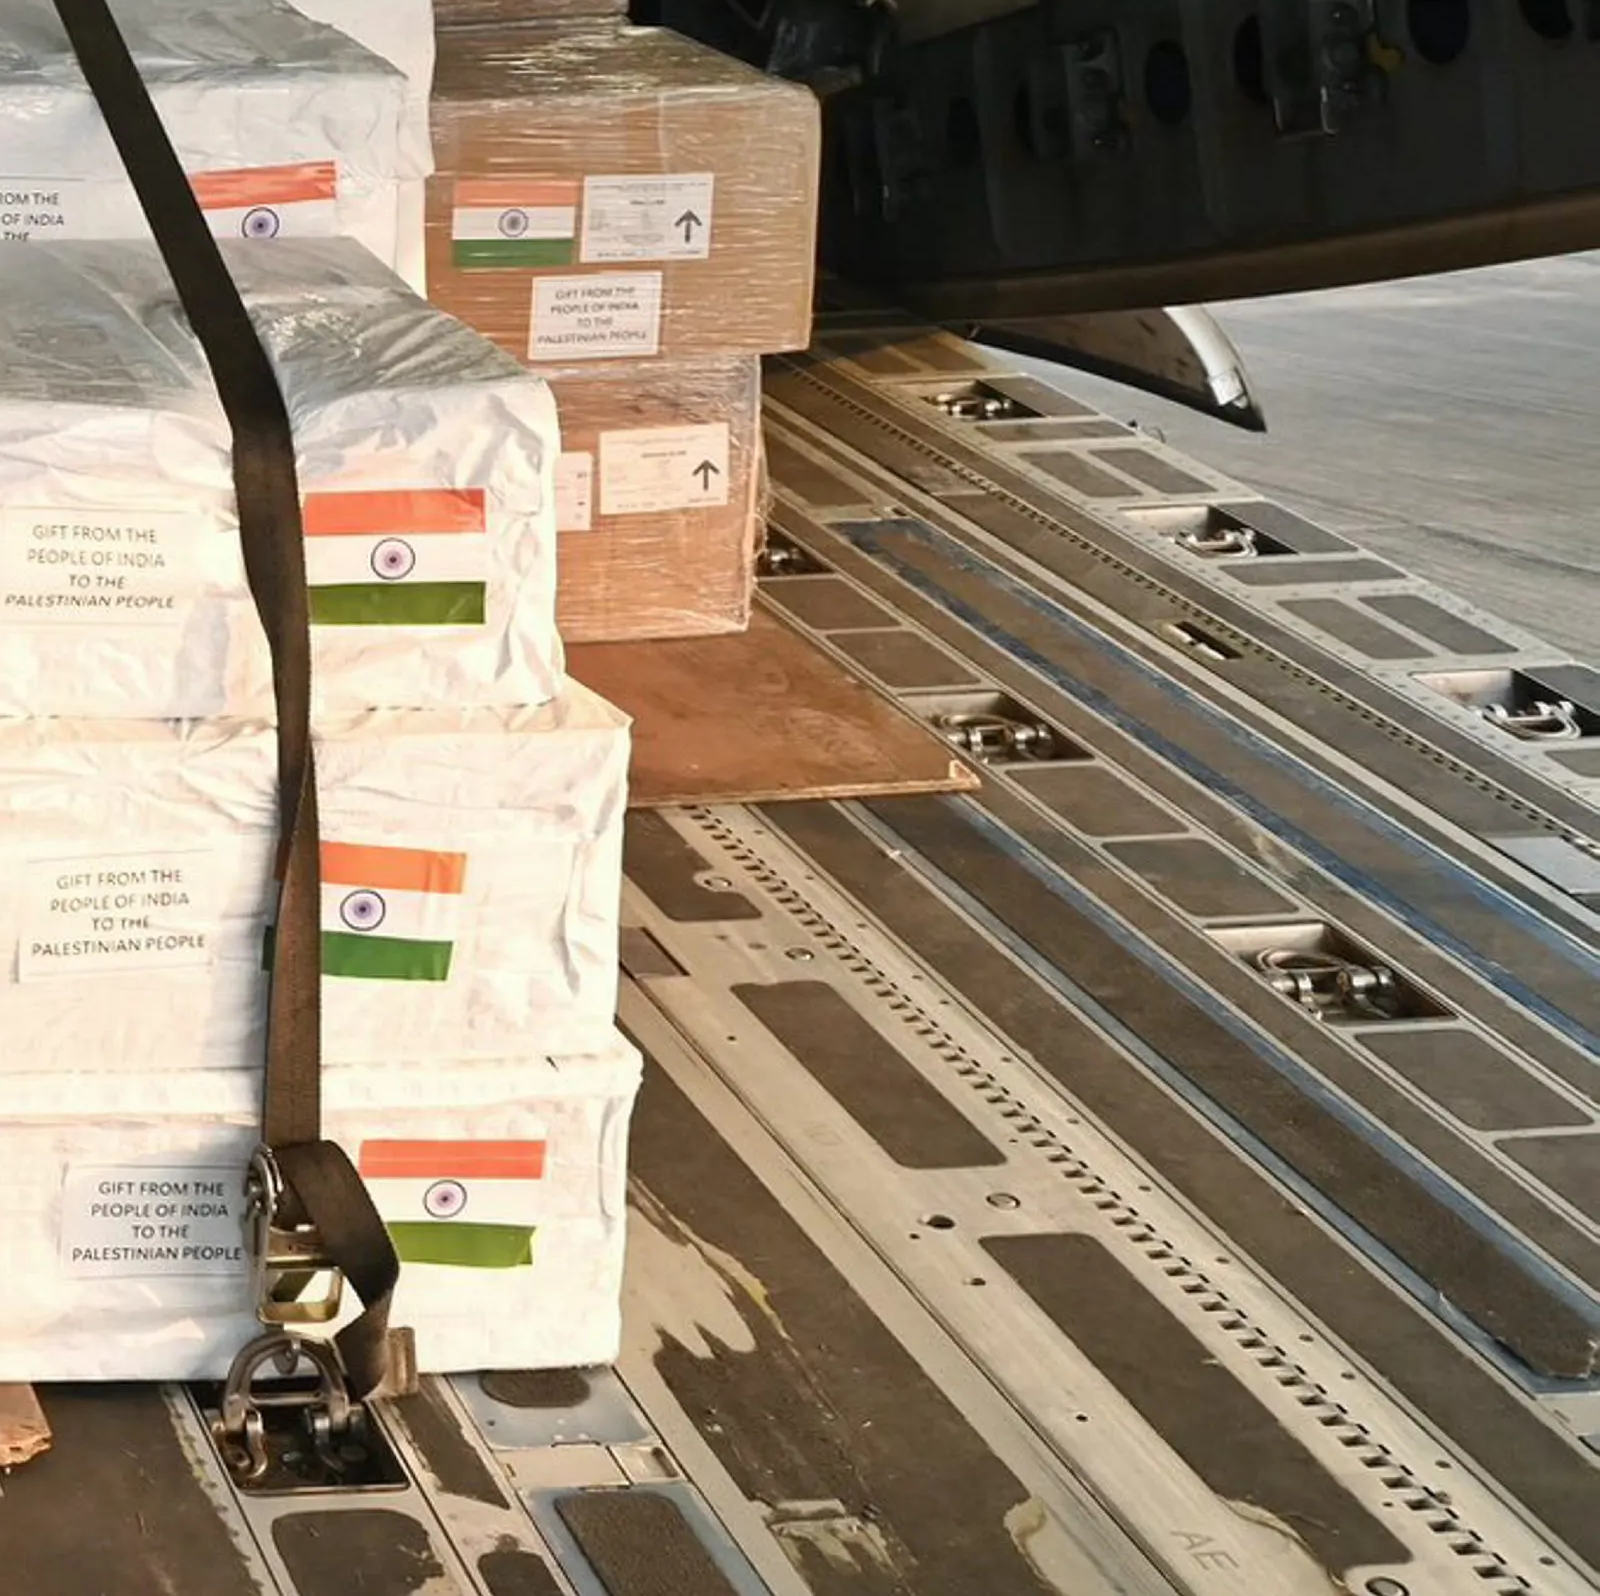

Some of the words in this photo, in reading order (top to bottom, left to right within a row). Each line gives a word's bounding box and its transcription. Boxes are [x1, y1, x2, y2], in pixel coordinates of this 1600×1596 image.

[32, 192, 58, 206] THE
[0, 213, 21, 226] OF
[26, 213, 64, 226] INDIA
[4, 231, 31, 243] THE
[33, 524, 68, 540] GIFT
[73, 525, 121, 542] FROM
[126, 527, 156, 544] THE
[28, 548, 86, 566] PEOPLE
[91, 551, 112, 566] OF
[119, 553, 165, 568] INDIA
[69, 574, 91, 589] TO
[96, 575, 125, 590] THE
[5, 594, 112, 608] PALESTINIAN
[115, 595, 173, 609] PEOPLE
[56, 874, 91, 890] GIFT
[98, 871, 146, 886] FROM
[150, 869, 181, 883] THE
[51, 895, 109, 913] PEOPLE
[114, 894, 134, 909] OF
[143, 892, 190, 907] INDIA
[92, 917, 114, 931] TO
[121, 915, 150, 930] THE
[32, 938, 141, 956] PALESTINIAN
[145, 935, 204, 951] PEOPLE
[98, 1182, 135, 1195] GIFT
[140, 1182, 188, 1196] FROM
[194, 1182, 223, 1196] THE
[91, 1203, 150, 1218] PEOPLE
[155, 1203, 178, 1218] OF
[181, 1203, 229, 1218] INDIA
[132, 1224, 155, 1239] TO
[160, 1224, 190, 1239] THE
[72, 1247, 179, 1261] PALESTINIAN
[183, 1246, 242, 1261] PEOPLE
